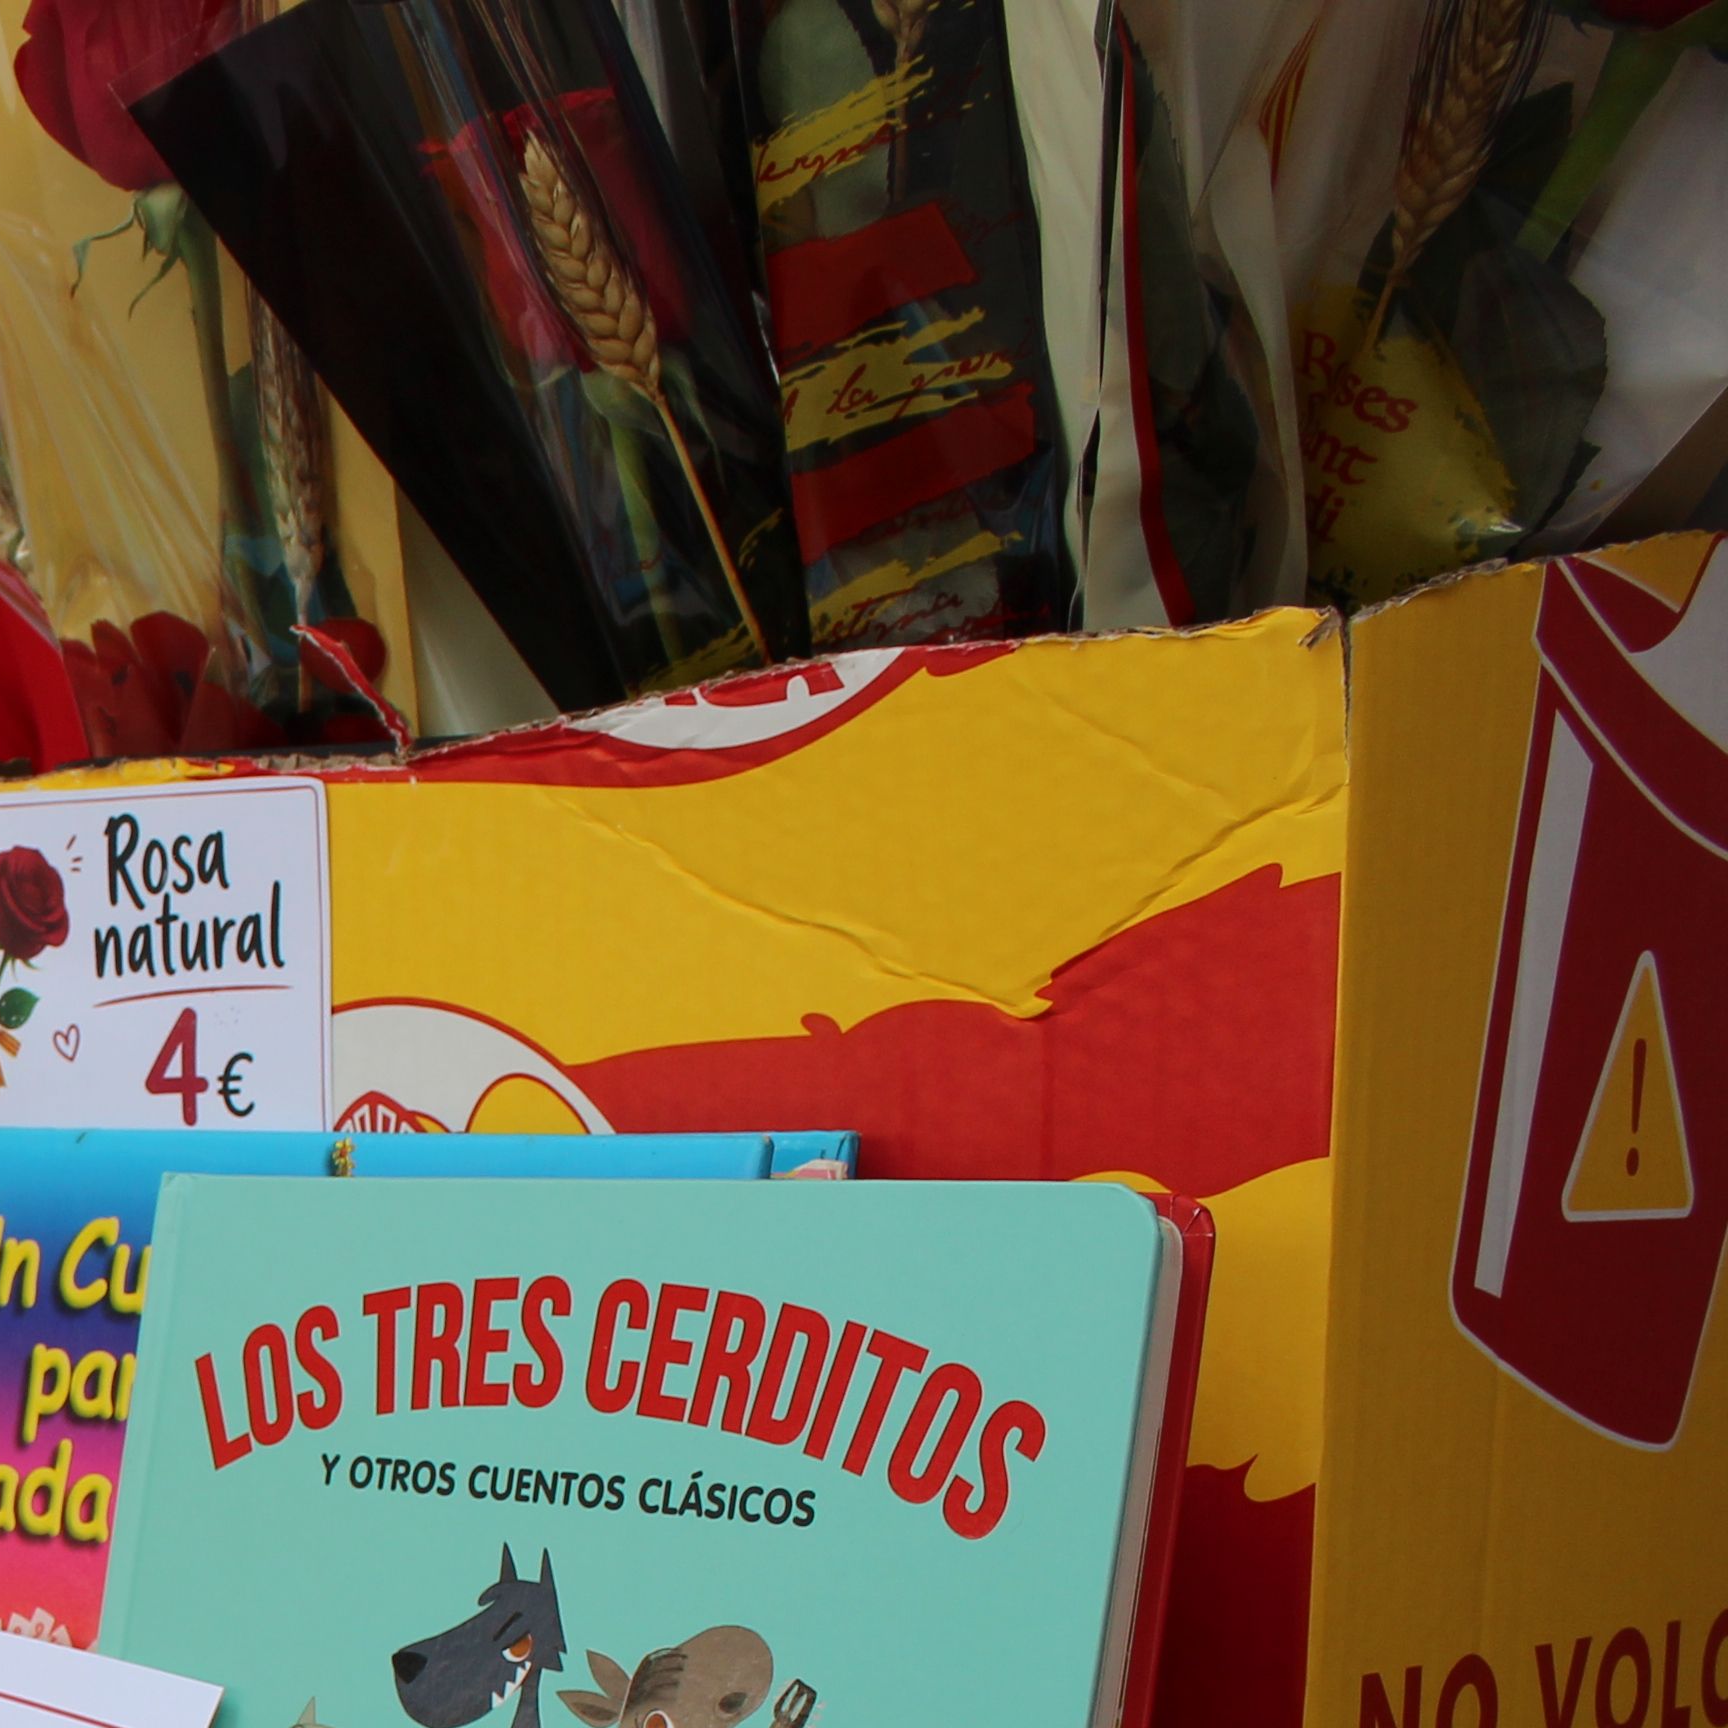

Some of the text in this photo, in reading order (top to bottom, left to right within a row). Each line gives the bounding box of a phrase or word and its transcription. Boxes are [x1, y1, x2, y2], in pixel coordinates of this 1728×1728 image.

[104, 813, 229, 909] Rosa
[94, 881, 285, 978] natural
[60, 1217, 153, 1313] Cu
[194, 1275, 1046, 1541] LOS TRES CERDITOS
[321, 1453, 816, 1527] Y OTROS CUENTOS CLÁSICOS
